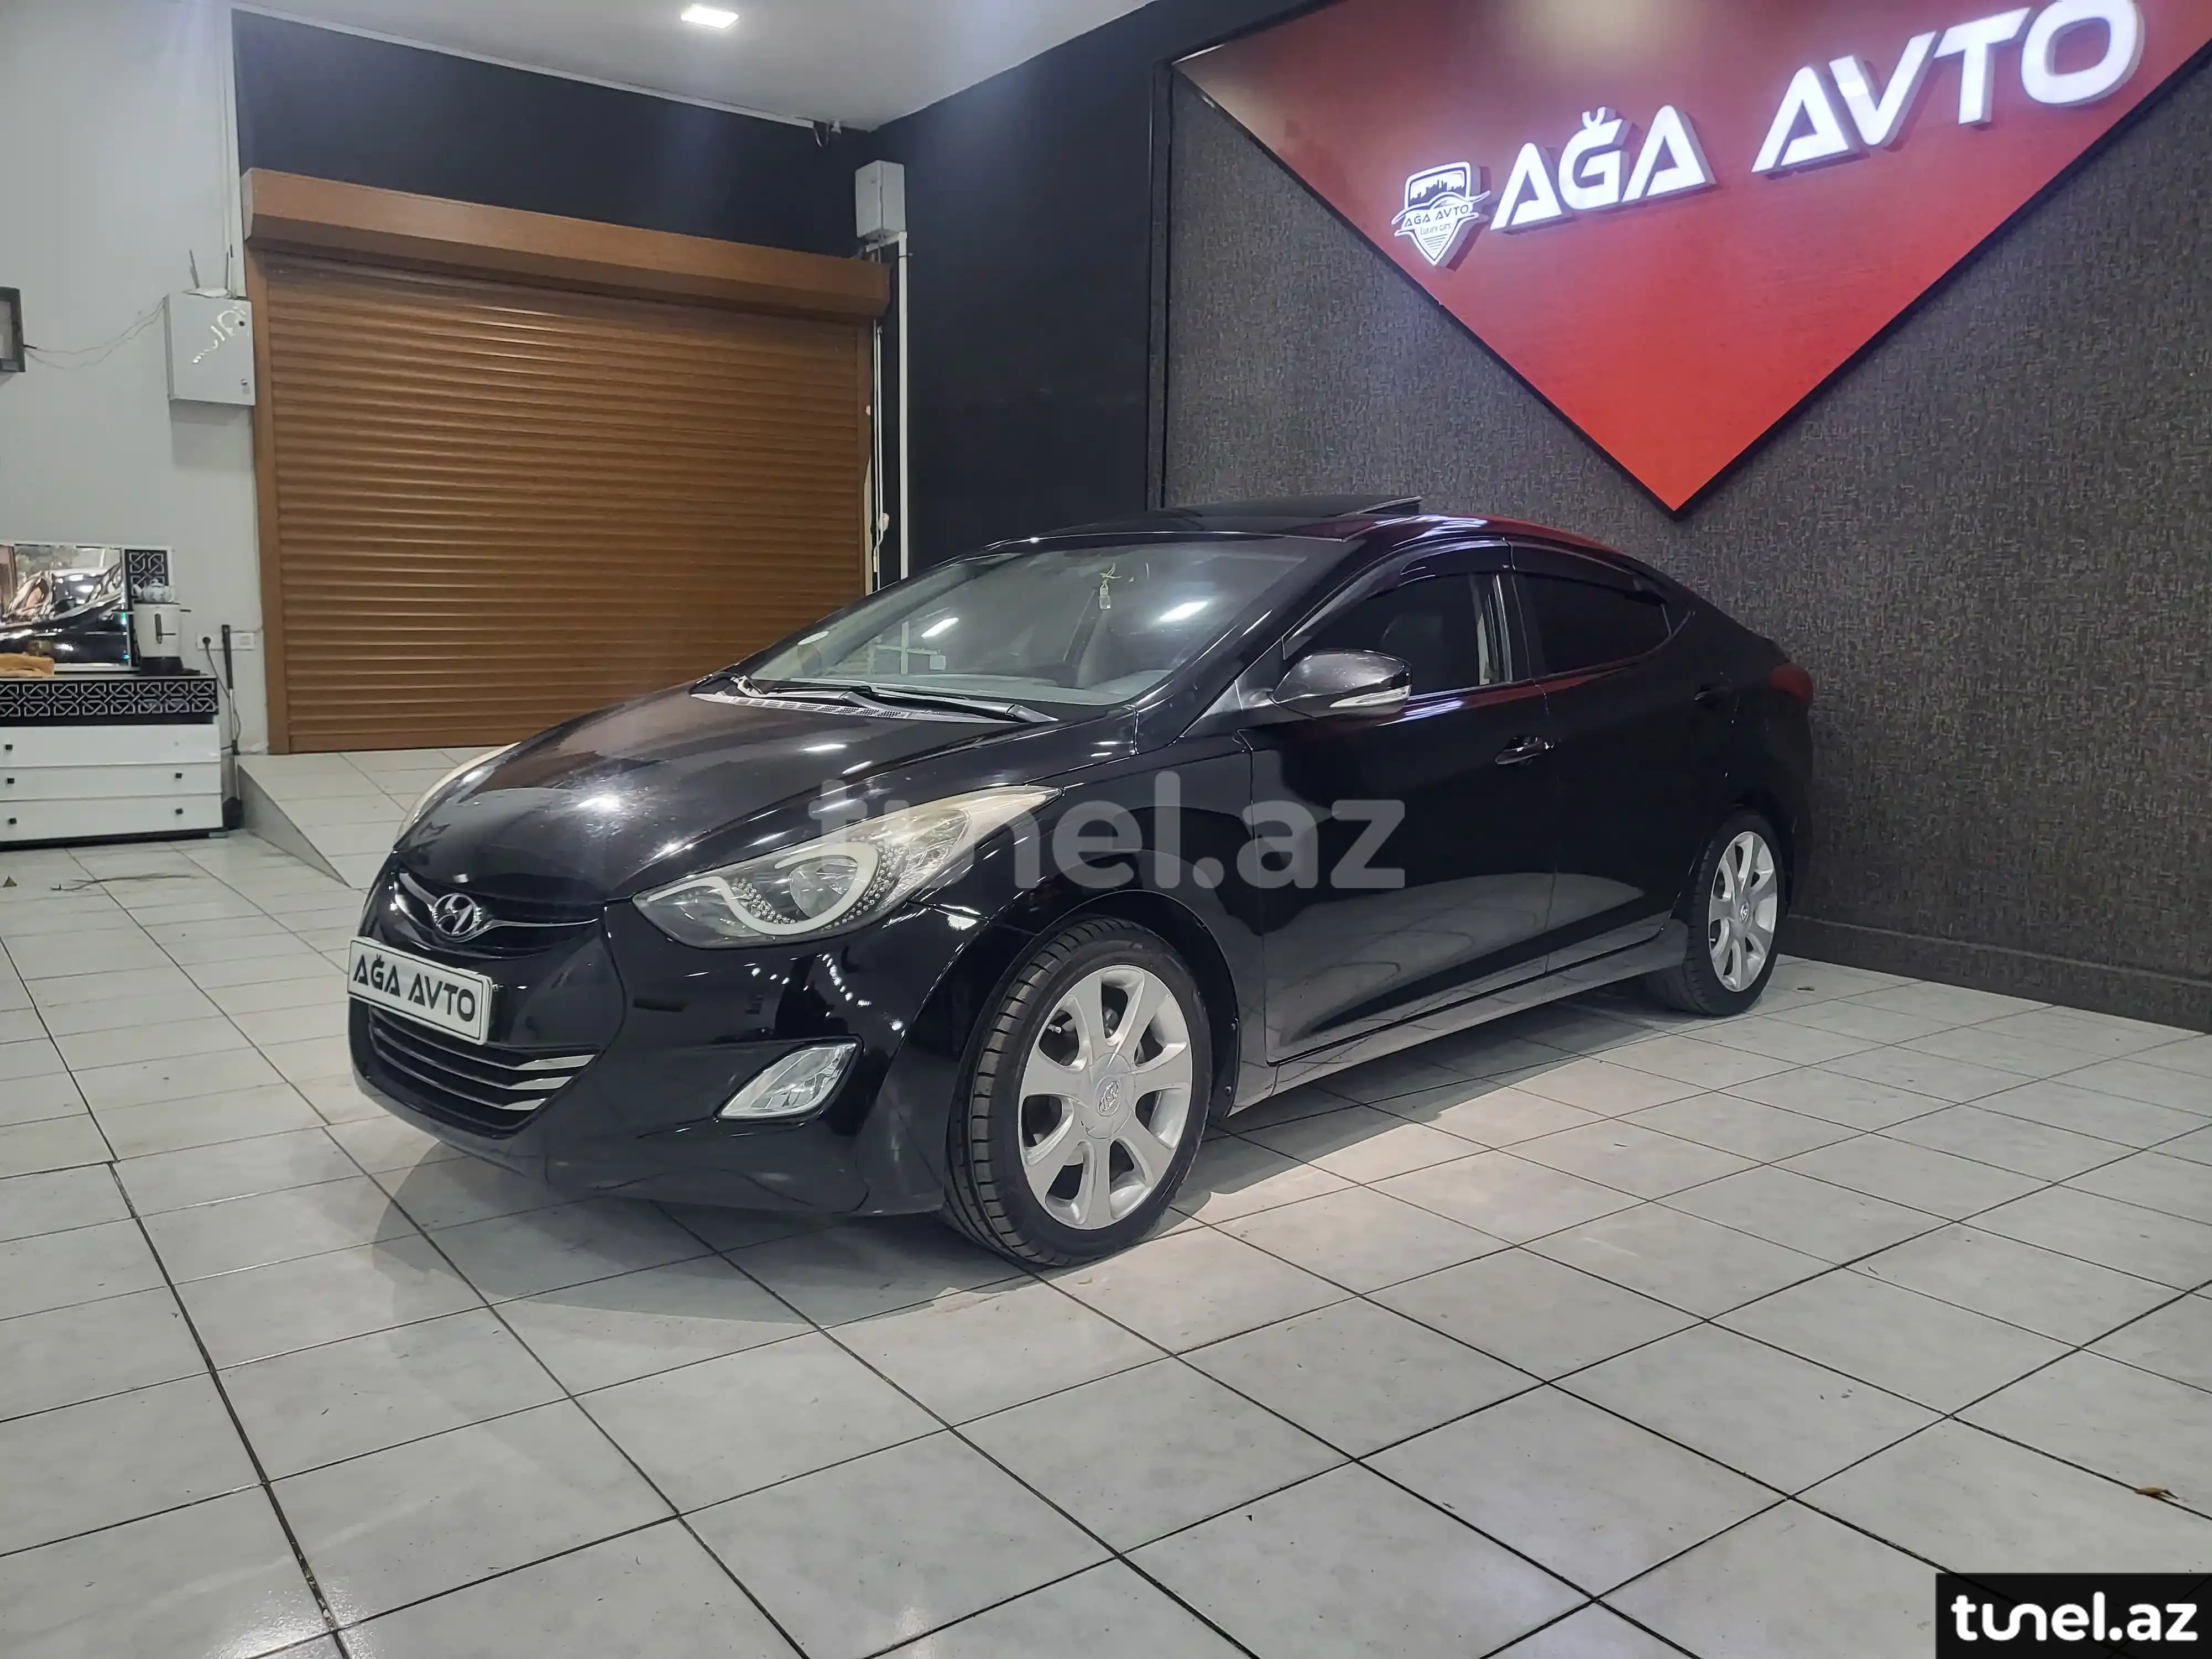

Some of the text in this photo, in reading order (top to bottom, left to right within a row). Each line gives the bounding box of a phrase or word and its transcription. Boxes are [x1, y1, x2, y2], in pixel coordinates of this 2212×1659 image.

[1490, 0, 2142, 231] AĞA AVTO
[1435, 204, 1469, 221] AVTO
[353, 953, 476, 1022] AĞA AVTO
